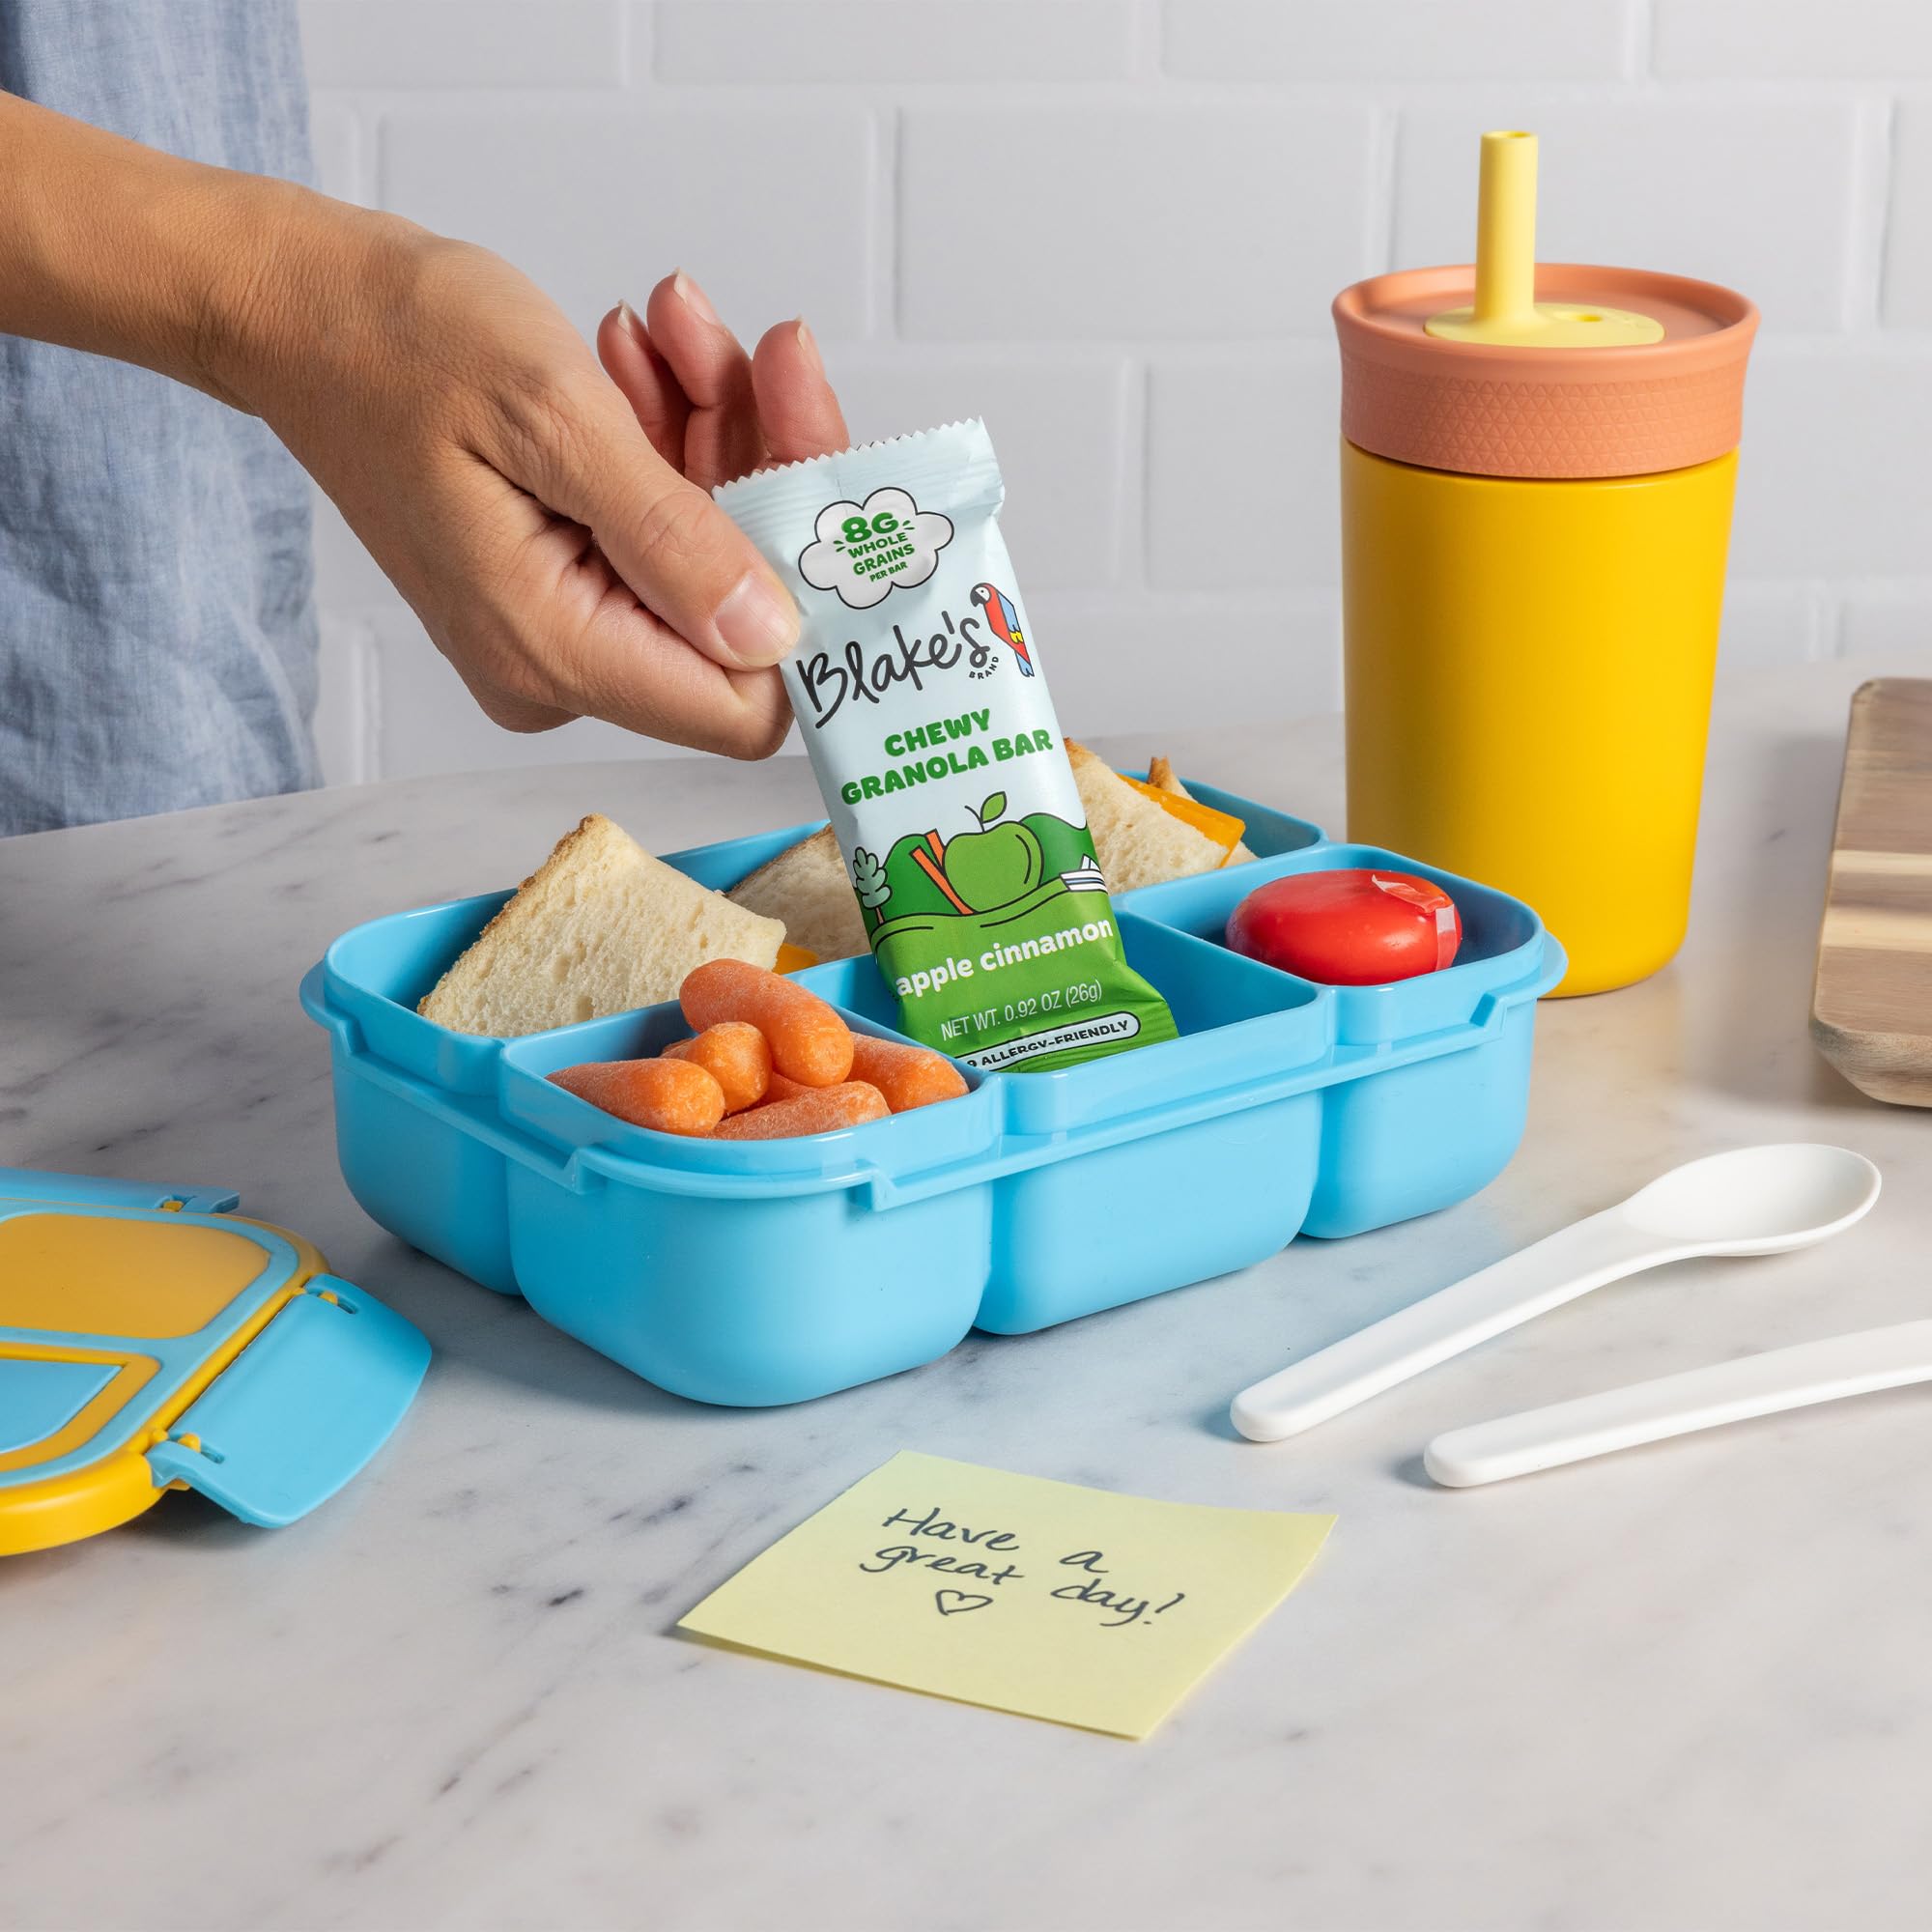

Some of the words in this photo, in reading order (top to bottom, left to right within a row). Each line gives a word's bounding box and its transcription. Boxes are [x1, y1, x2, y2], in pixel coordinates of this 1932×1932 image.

[841, 512, 898, 543] 8G
[848, 532, 908, 558] WHOLE
[853, 544, 915, 576] GRAINS
[869, 569, 888, 582] PER
[888, 561, 908, 574] BAR
[796, 611, 990, 728] Blake's
[969, 655, 999, 680] BRAND
[884, 708, 990, 757] CHEWY
[840, 753, 989, 805] GRANOLA
[991, 729, 1054, 762] BAR
[896, 957, 974, 997] apple
[980, 921, 1113, 971] cinnamon
[940, 1016, 970, 1041] NET
[972, 1009, 1001, 1032] WT.
[1004, 998, 1037, 1022] 0.92
[1040, 990, 1062, 1011] OZ
[1065, 979, 1103, 1009] (26g)
[981, 1020, 1128, 1065] ALLERGY-FRIENDLY
[881, 1507, 1020, 1551] Have
[1059, 1550, 1110, 1574] a
[859, 1546, 1025, 1585] great
[1049, 1577, 1186, 1627] day!
